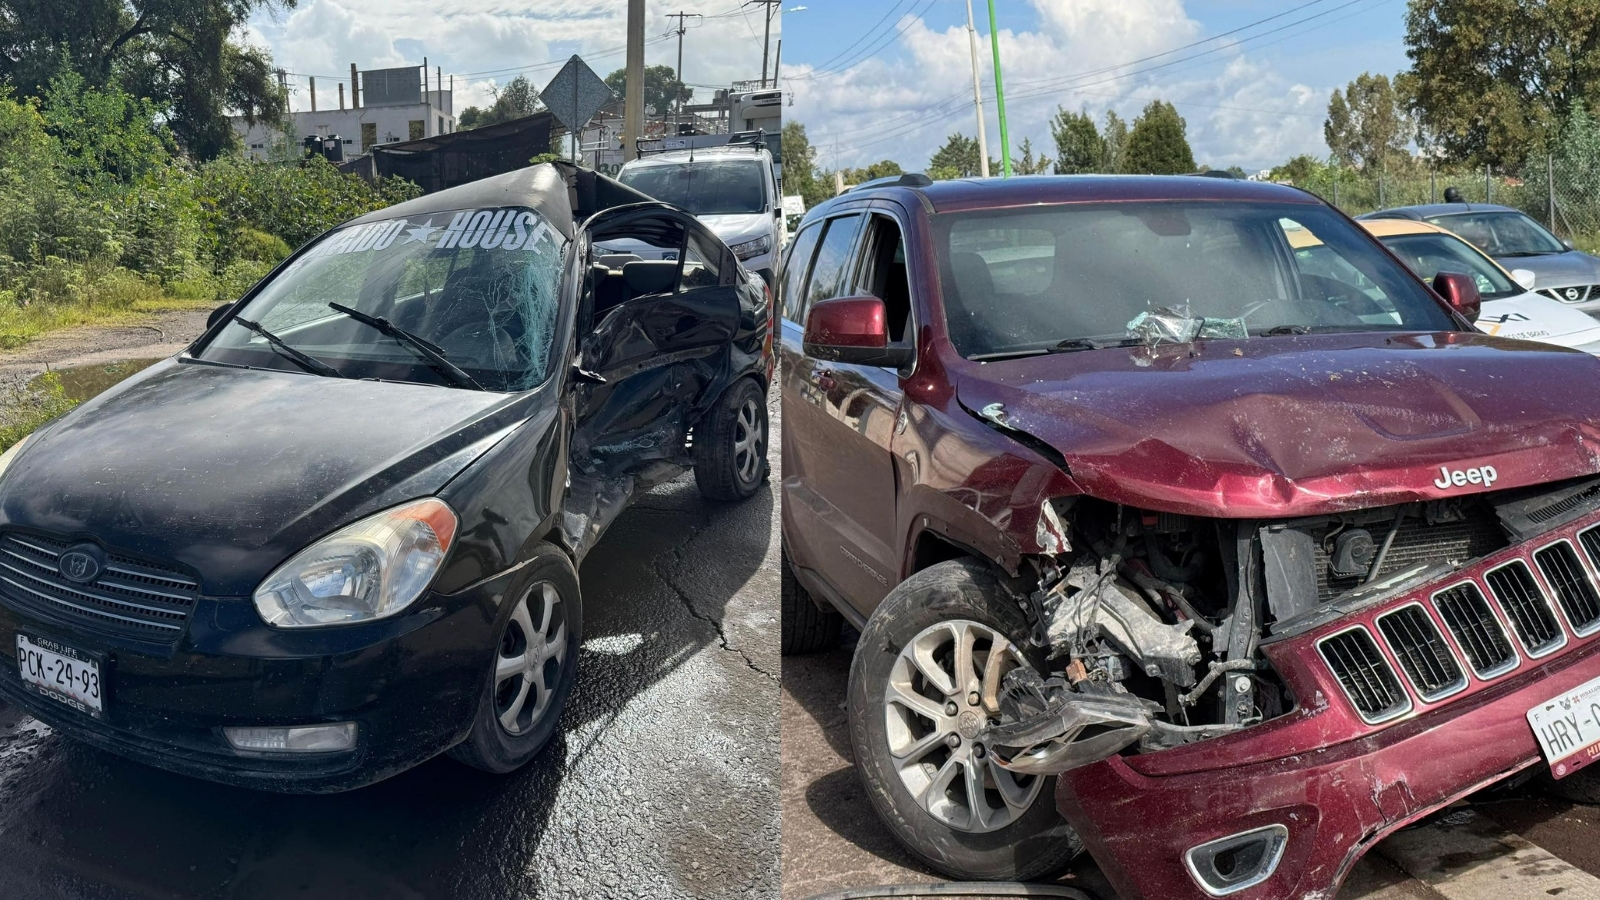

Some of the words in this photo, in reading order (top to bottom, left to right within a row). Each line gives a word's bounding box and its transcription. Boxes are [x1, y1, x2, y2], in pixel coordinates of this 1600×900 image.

[435, 210, 555, 255] HOUSE
[1433, 465, 1498, 489] Jeep
[37, 637, 59, 650] GRAB
[60, 644, 78, 656] LIFE
[18, 647, 99, 699] PCK-24-93
[39, 686, 86, 713] DODGE
